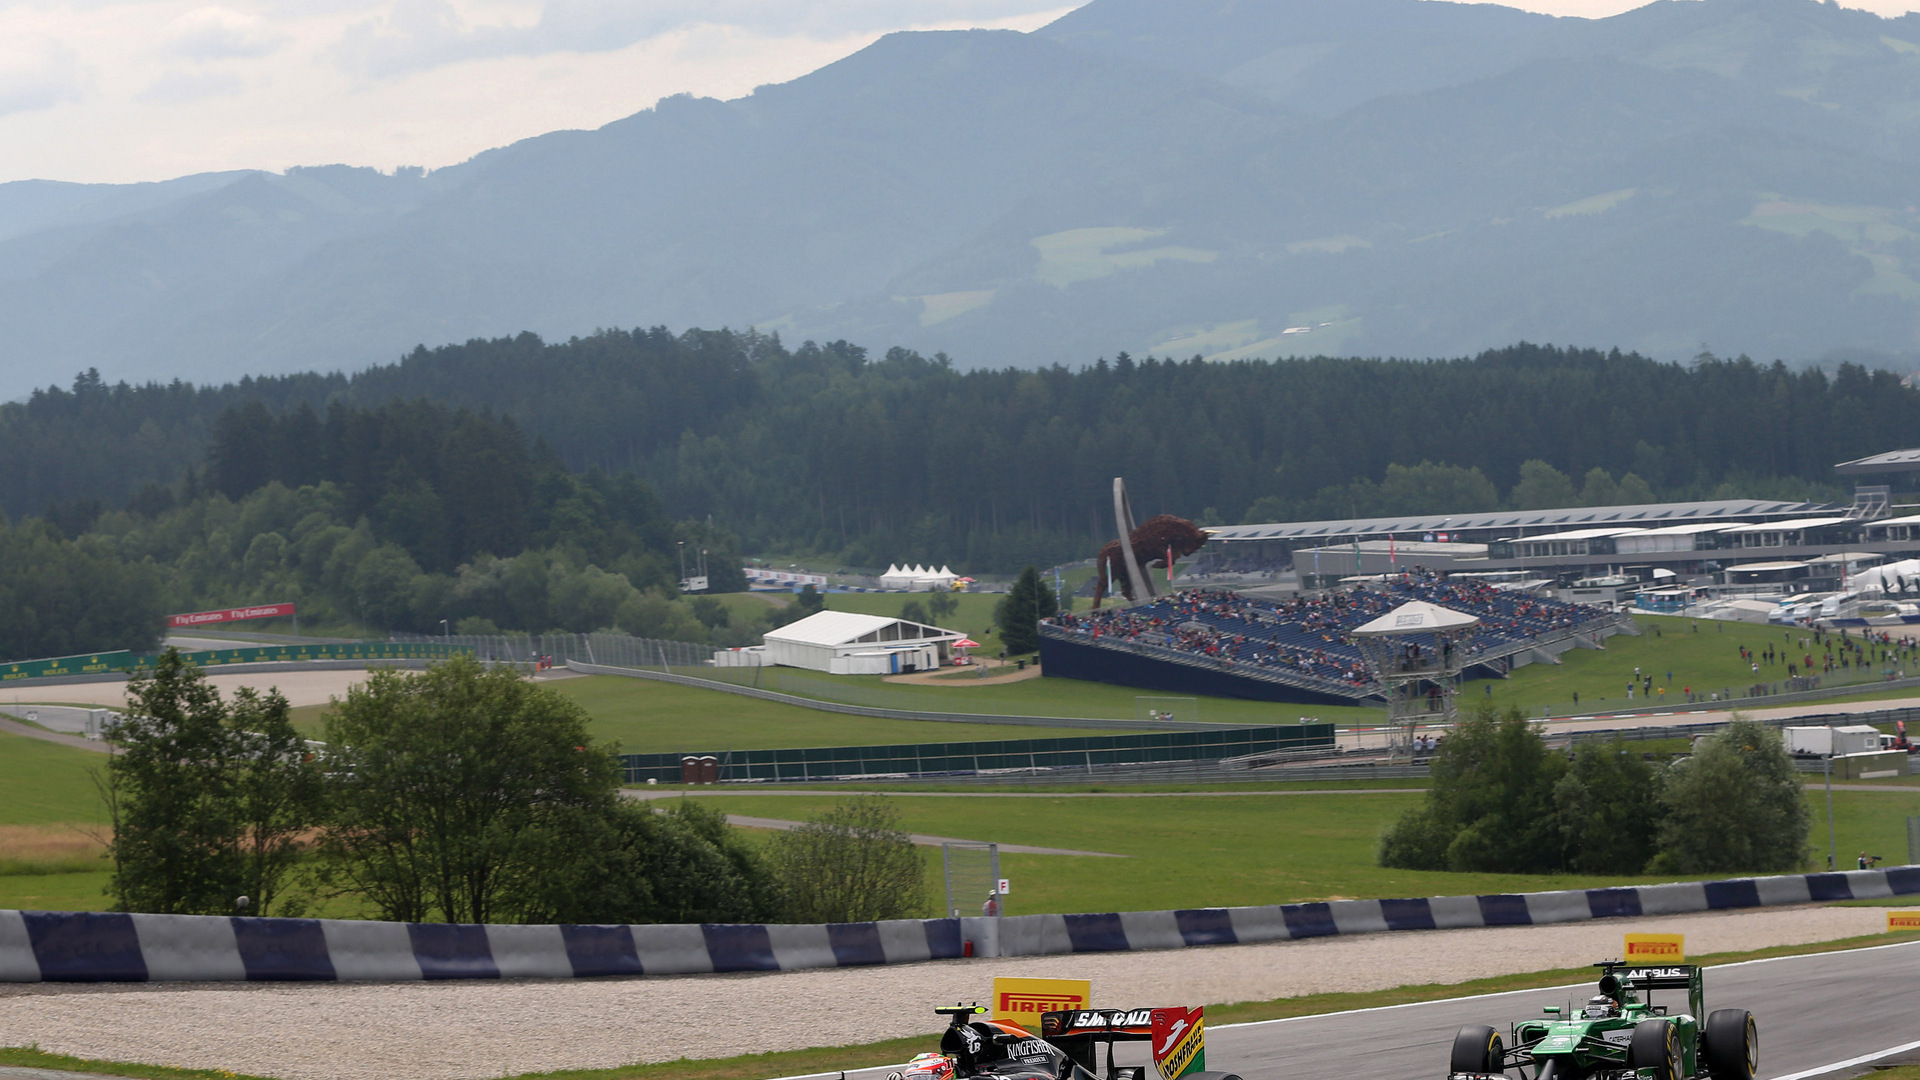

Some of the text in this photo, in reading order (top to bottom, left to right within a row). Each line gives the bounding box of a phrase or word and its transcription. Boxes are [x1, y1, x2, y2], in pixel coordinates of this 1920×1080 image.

[176, 613, 222, 625] Fly Emirates
[231, 607, 278, 619] Fly Emirates
[1628, 942, 1679, 955] PIRELLI
[1626, 968, 1681, 979] AIRBUS
[1007, 1039, 1056, 1060] KINGFISHER
